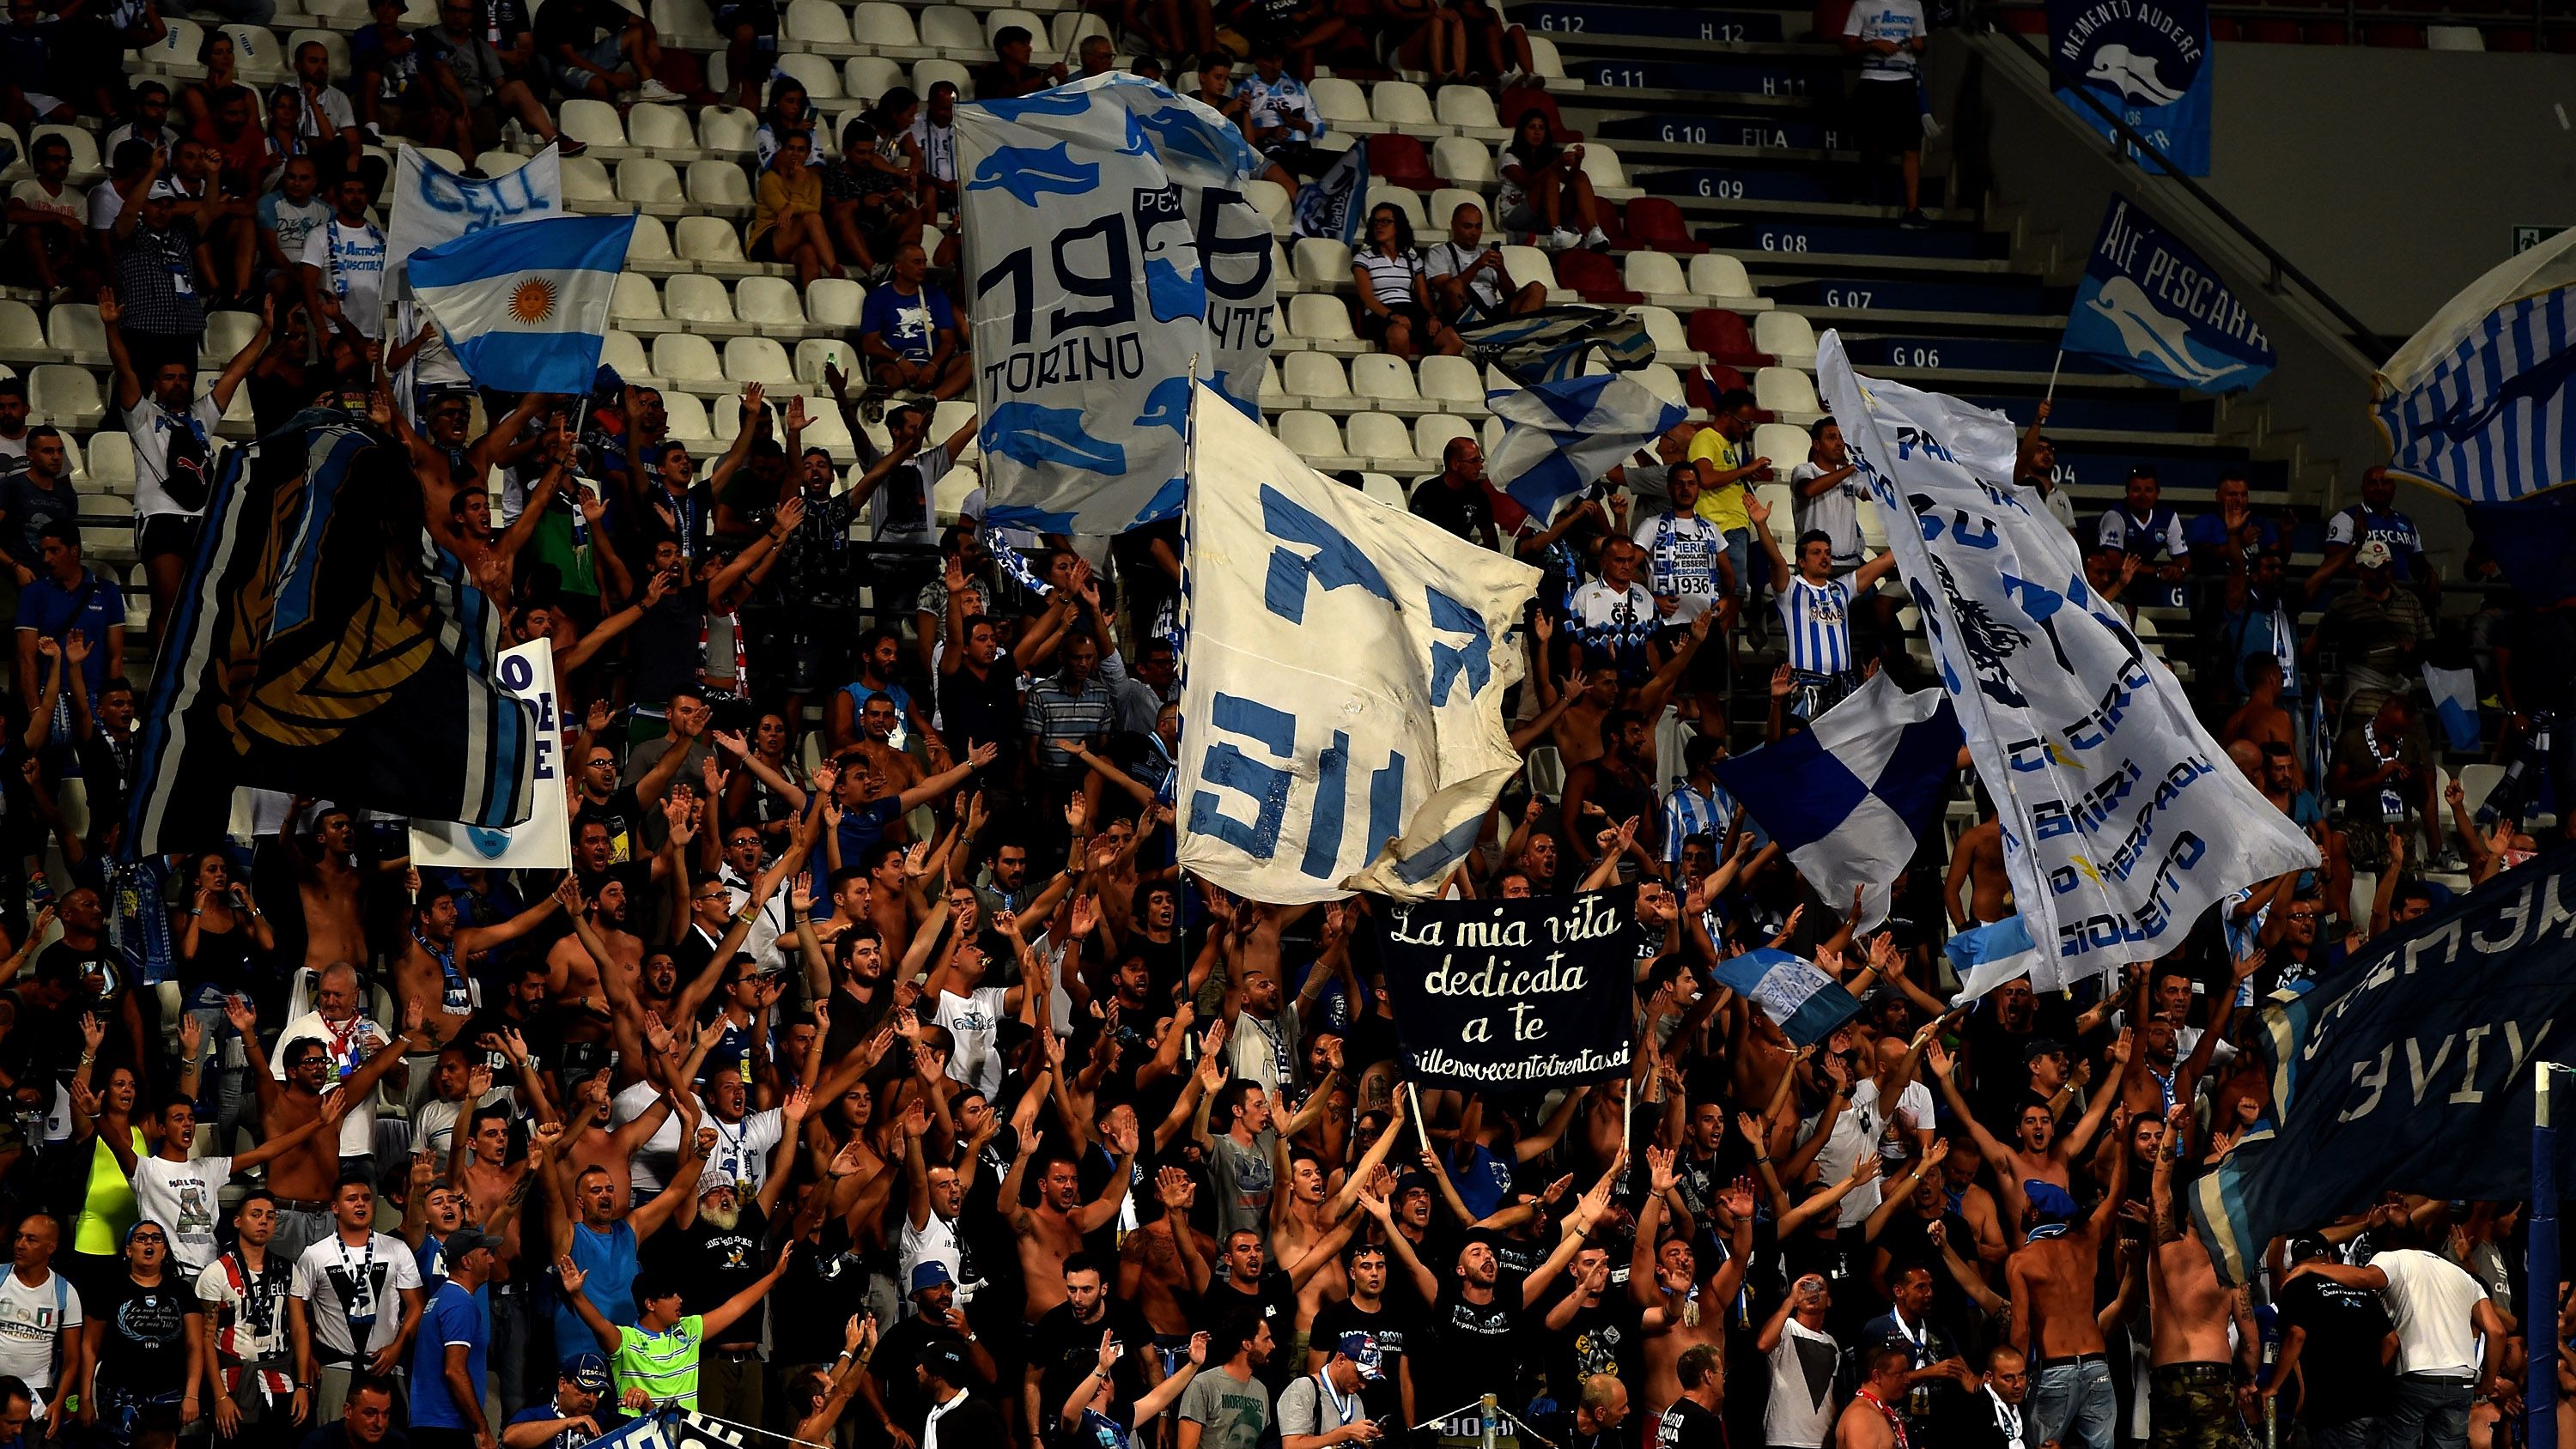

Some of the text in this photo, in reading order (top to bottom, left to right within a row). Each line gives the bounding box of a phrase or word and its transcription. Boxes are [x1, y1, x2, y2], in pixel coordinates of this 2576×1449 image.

[1541, 15, 1584, 33] G 12
[1701, 23, 1744, 42] H 12
[2061, 0, 2202, 63] MEMENTO AUDERE
[1601, 70, 1644, 88] G 11
[1763, 78, 1807, 96] H 11
[1662, 125, 1837, 149] G 10 FILA H
[1699, 179, 1744, 199] G 09
[1762, 233, 1807, 252] G 08
[1827, 290, 1872, 309] G 07
[2143, 251, 2271, 353] PESCARA
[985, 331, 1144, 404] TORINO
[1893, 349, 1939, 367] G 06
[1674, 577, 1710, 595] 1936
[2171, 587, 2184, 607] G
[501, 654, 533, 691] O
[1390, 888, 1622, 948] La mia vita
[1425, 950, 1589, 997] dedicata
[1461, 1001, 1548, 1043] a te
